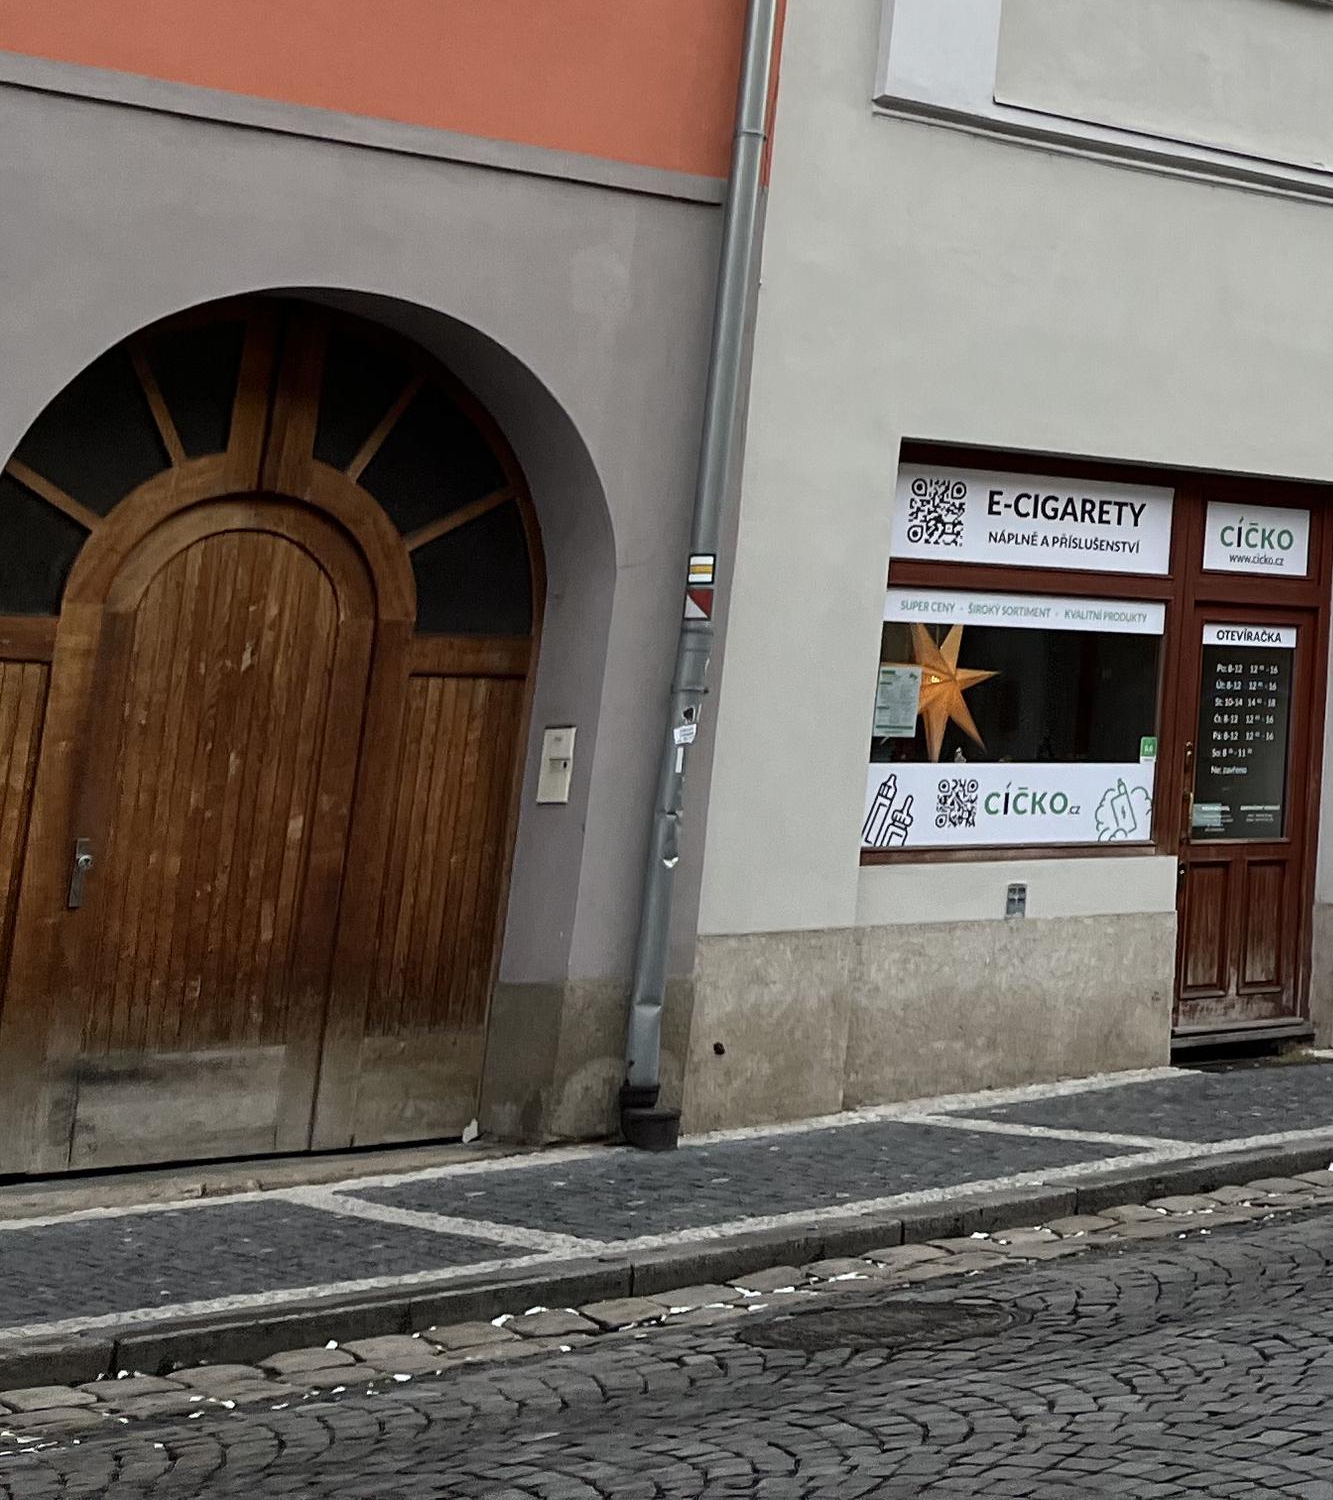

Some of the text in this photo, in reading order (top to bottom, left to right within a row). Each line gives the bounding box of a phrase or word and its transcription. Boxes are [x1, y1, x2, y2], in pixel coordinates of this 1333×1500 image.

[987, 490, 1147, 527] E-CIGARETY
[1040, 534, 1050, 547] A
[1052, 532, 1141, 553] PŘÍSLUŠENSTVÍ
[900, 600, 930, 612] SUPER
[931, 602, 956, 614] CENY
[1002, 604, 1052, 618] SORTIMENT
[1102, 611, 1147, 622] PRODUKTY
[1216, 627, 1282, 643] OTEVÍRAČKA
